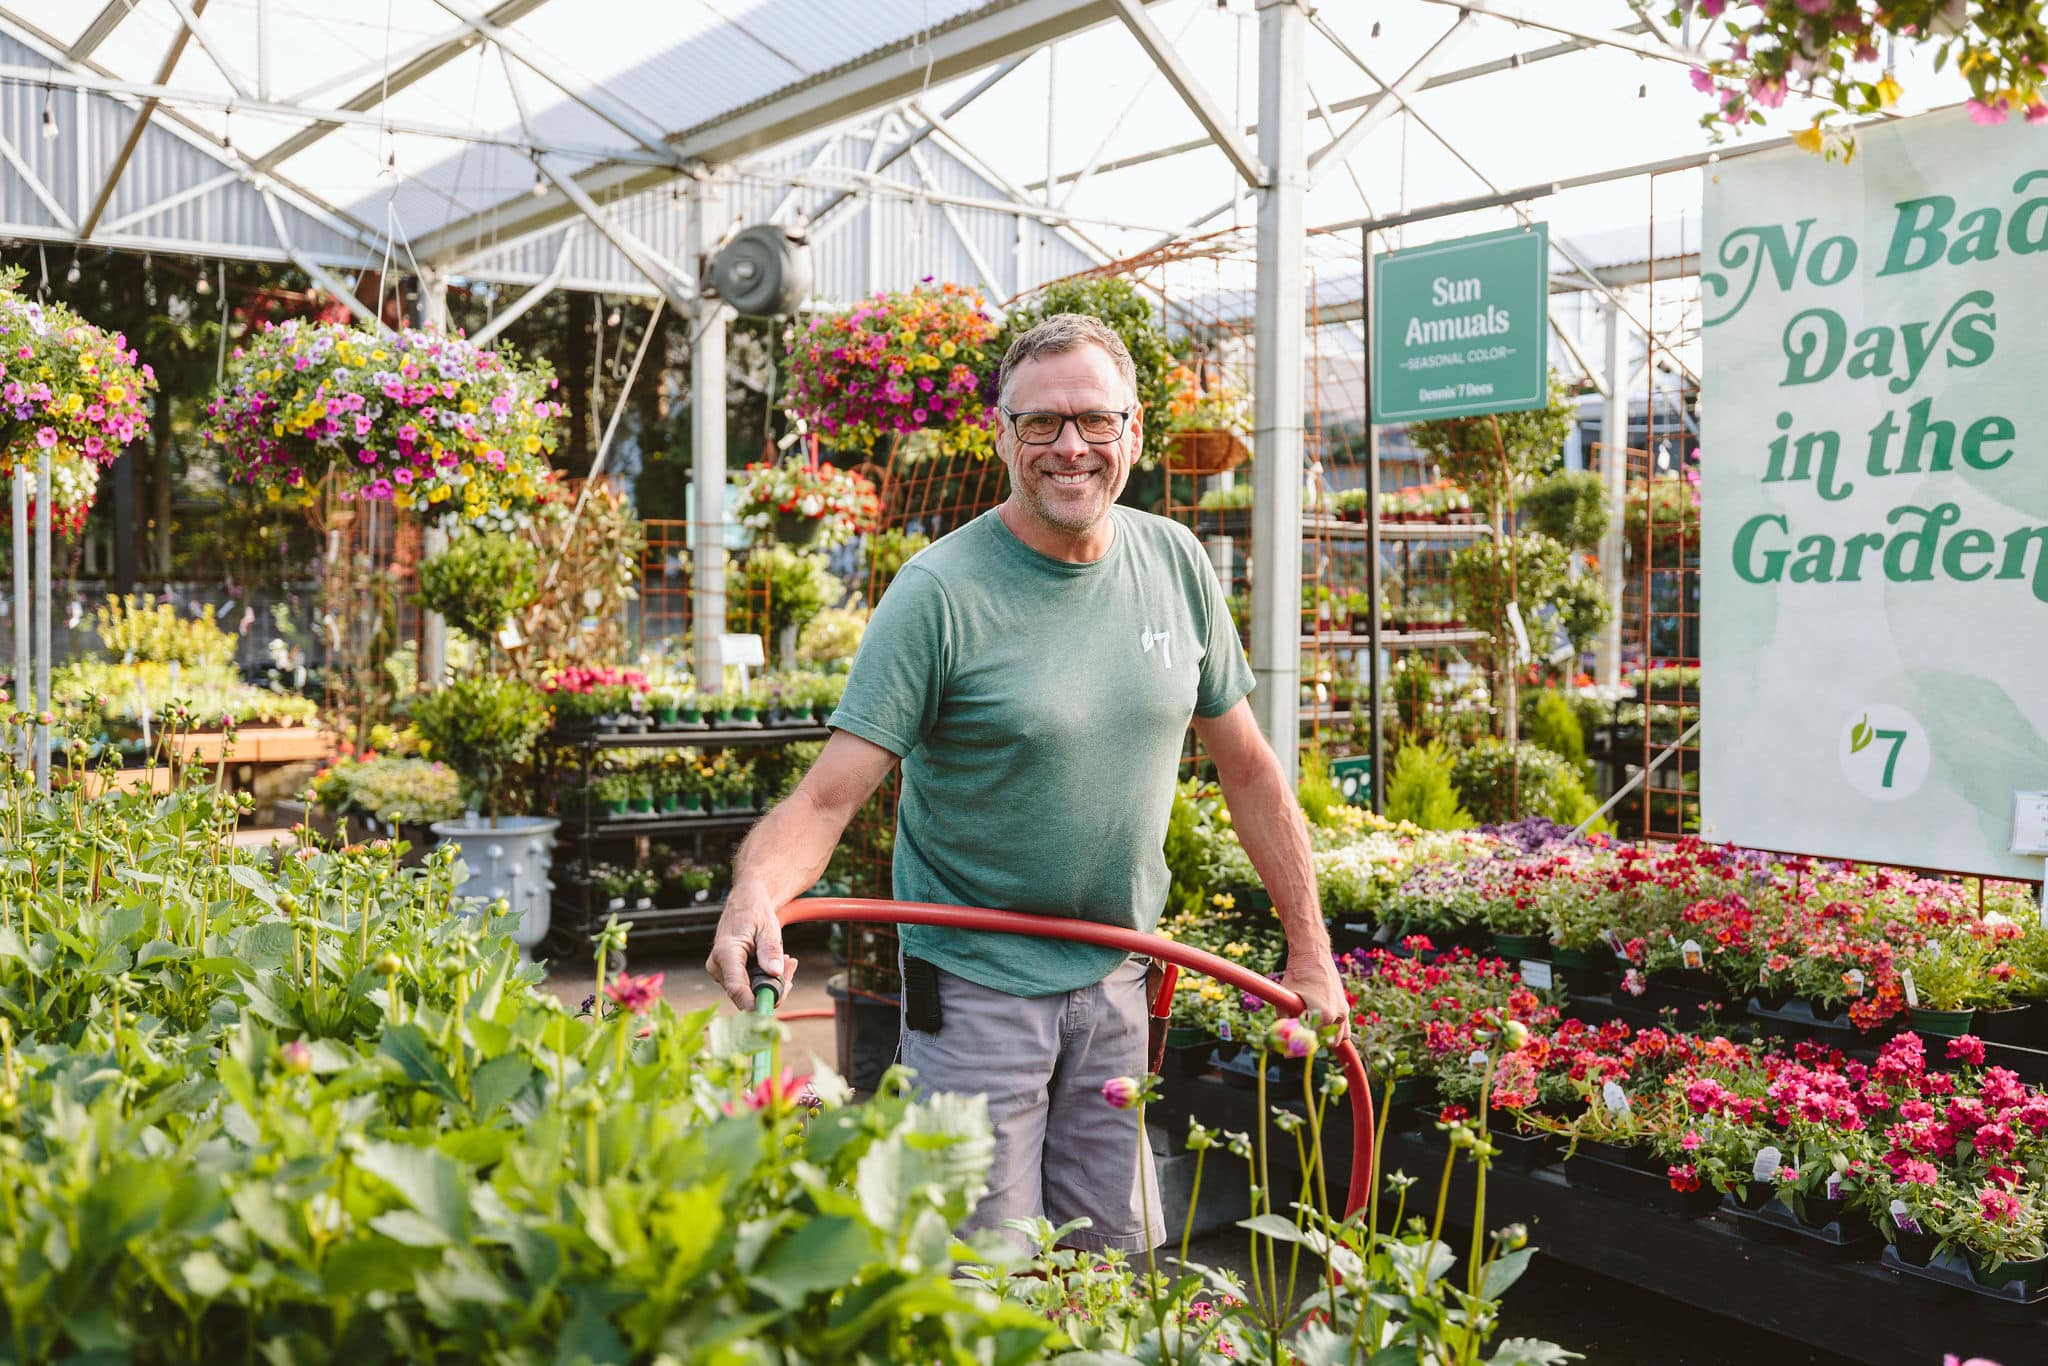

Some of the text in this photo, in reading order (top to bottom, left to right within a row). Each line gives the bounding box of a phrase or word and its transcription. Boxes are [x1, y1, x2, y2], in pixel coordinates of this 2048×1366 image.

[1431, 276, 1482, 307] Sun
[1701, 218, 1858, 328] No
[1404, 304, 1510, 347] Annuals
[1779, 290, 1997, 394] Days
[1407, 346, 1507, 370] SEASONAL COLOR
[1761, 397, 2016, 501] in the
[1732, 502, 2048, 604] Garden
[1152, 631, 1172, 669] 7
[1875, 728, 1908, 788] 7
